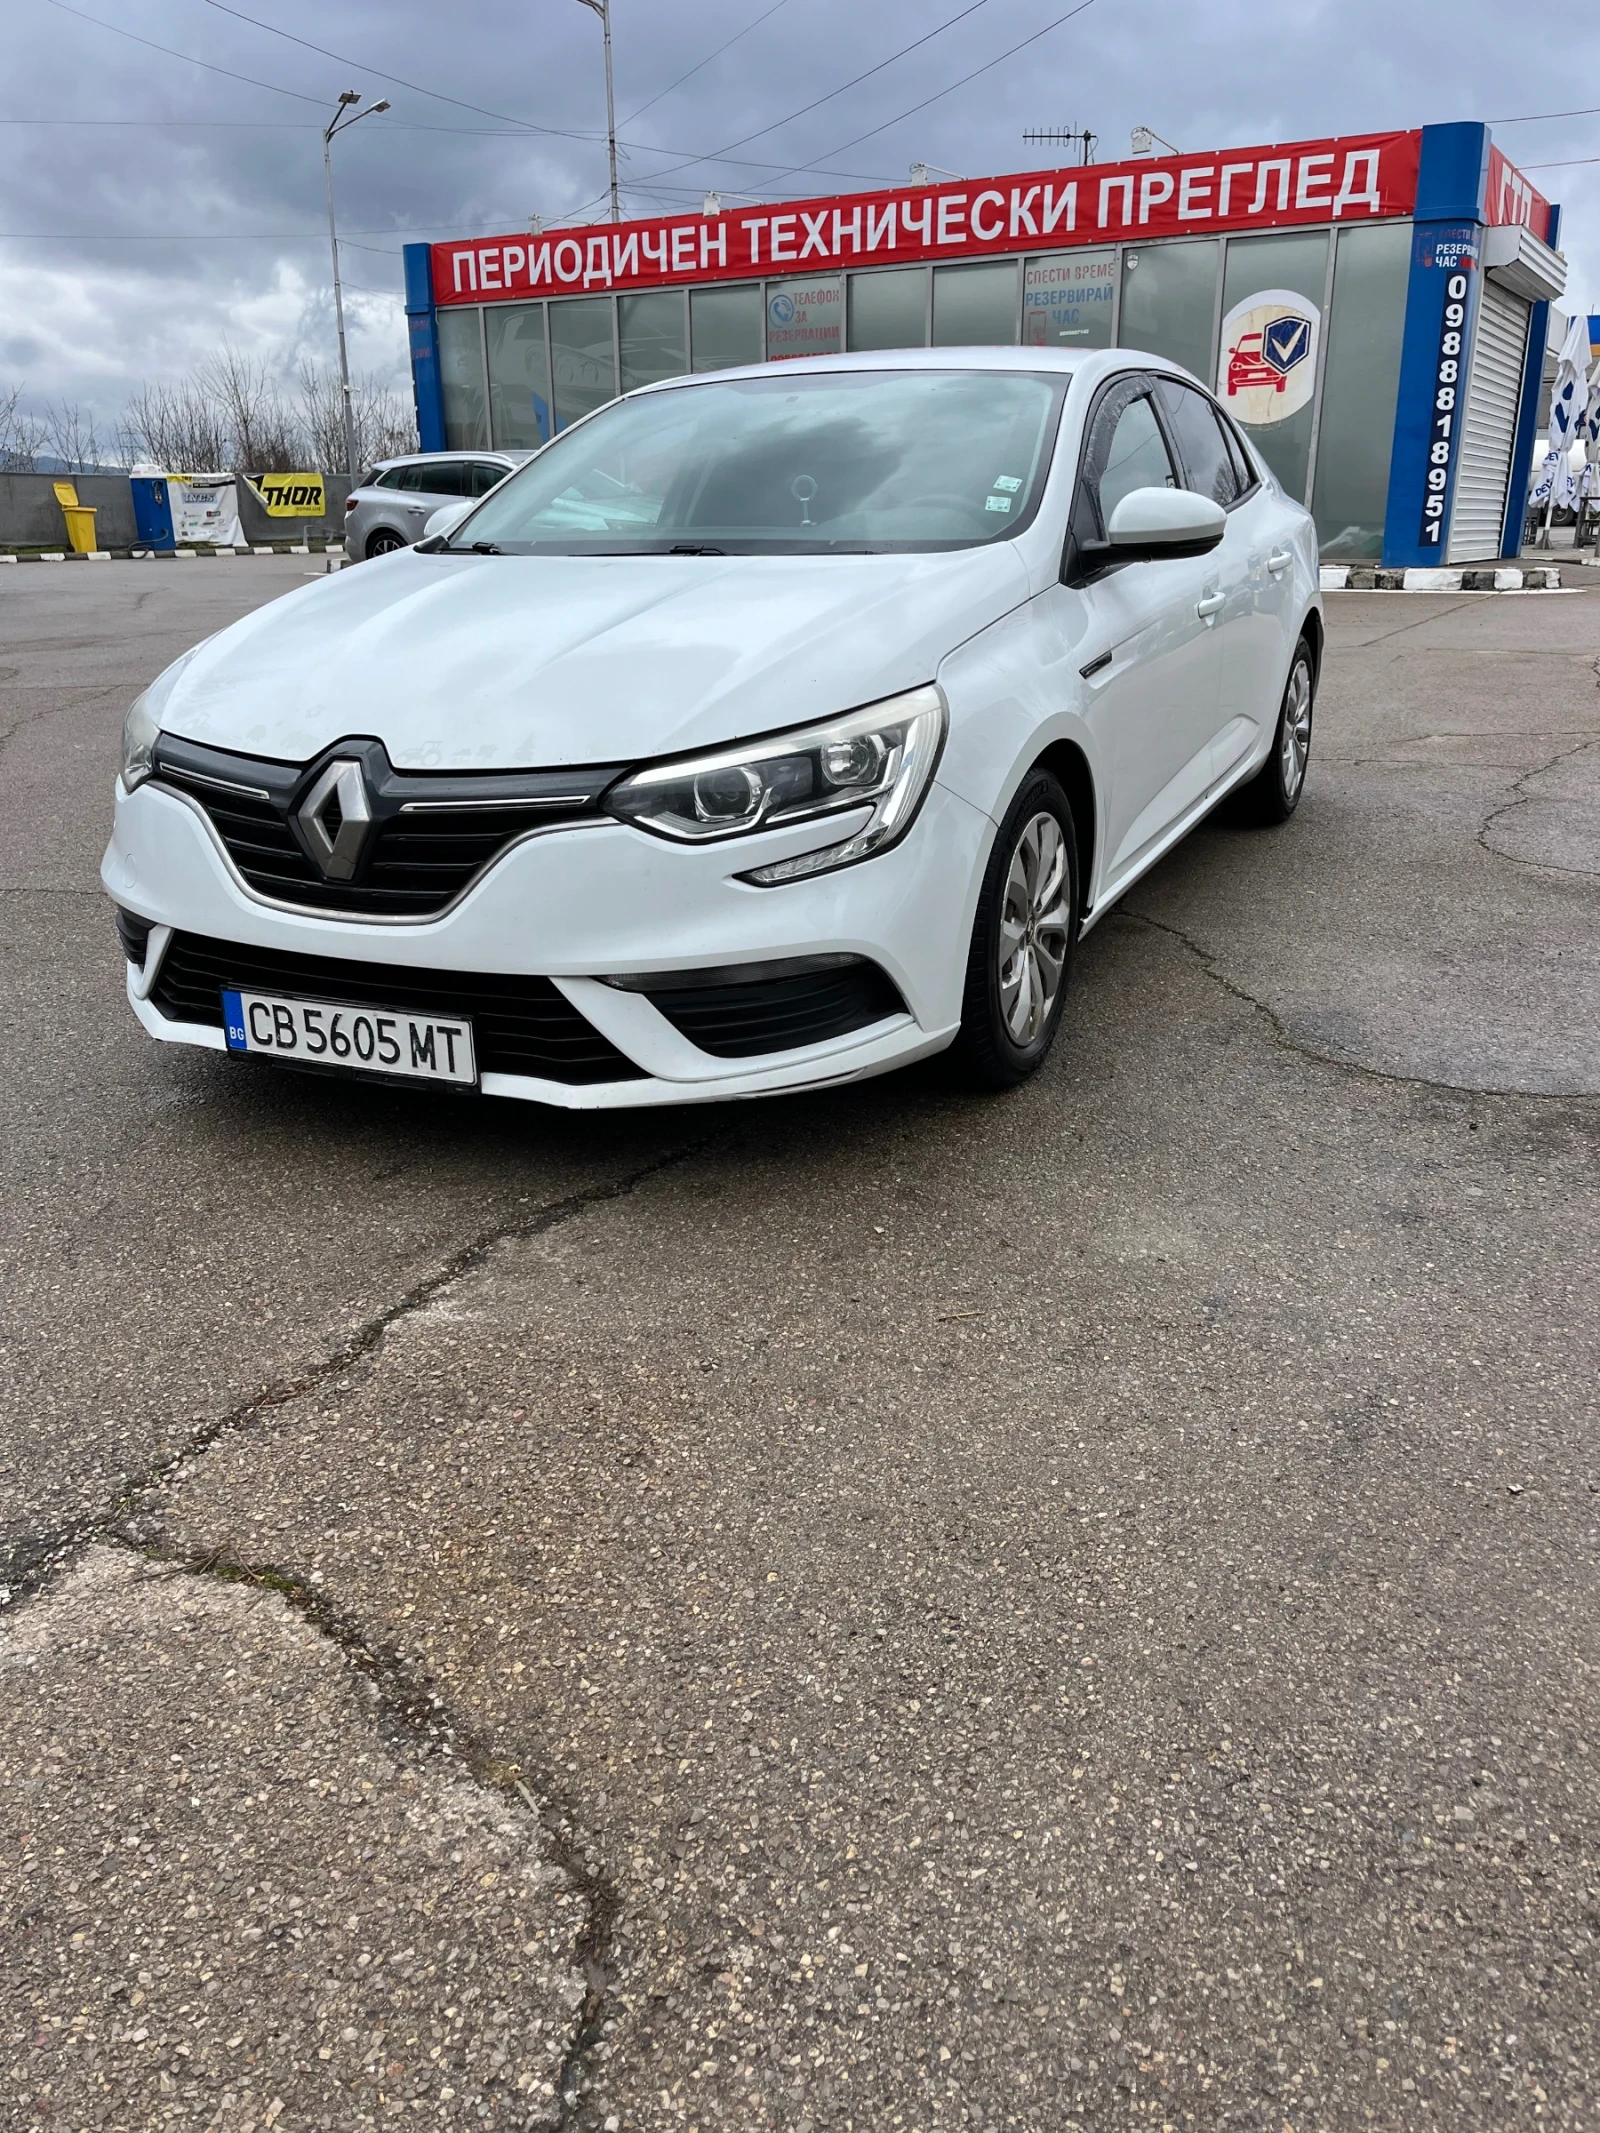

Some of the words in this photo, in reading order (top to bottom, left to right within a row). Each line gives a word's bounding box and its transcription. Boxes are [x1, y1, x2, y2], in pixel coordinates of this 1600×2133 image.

[452, 222, 727, 292] ПЕРИОДИЧЕН
[741, 181, 1078, 264] ТЕХНИЧЕСКИ
[1097, 149, 1381, 228] ПРЕГЛЕД
[1435, 256, 1457, 268] ЧАС
[1026, 267, 1071, 285] СПЕСТИ
[1074, 262, 1114, 281] ВРЕМЕ
[1025, 283, 1114, 307] РЕЗЕРВИРАЙ
[795, 310, 808, 323] ЗА
[1052, 308, 1080, 325] ЧАС
[768, 326, 840, 343] РЕЗЕРВАЦИИ
[1425, 275, 1467, 542] 0988818951
[263, 486, 323, 506] THOR
[229, 1026, 245, 1041] BG
